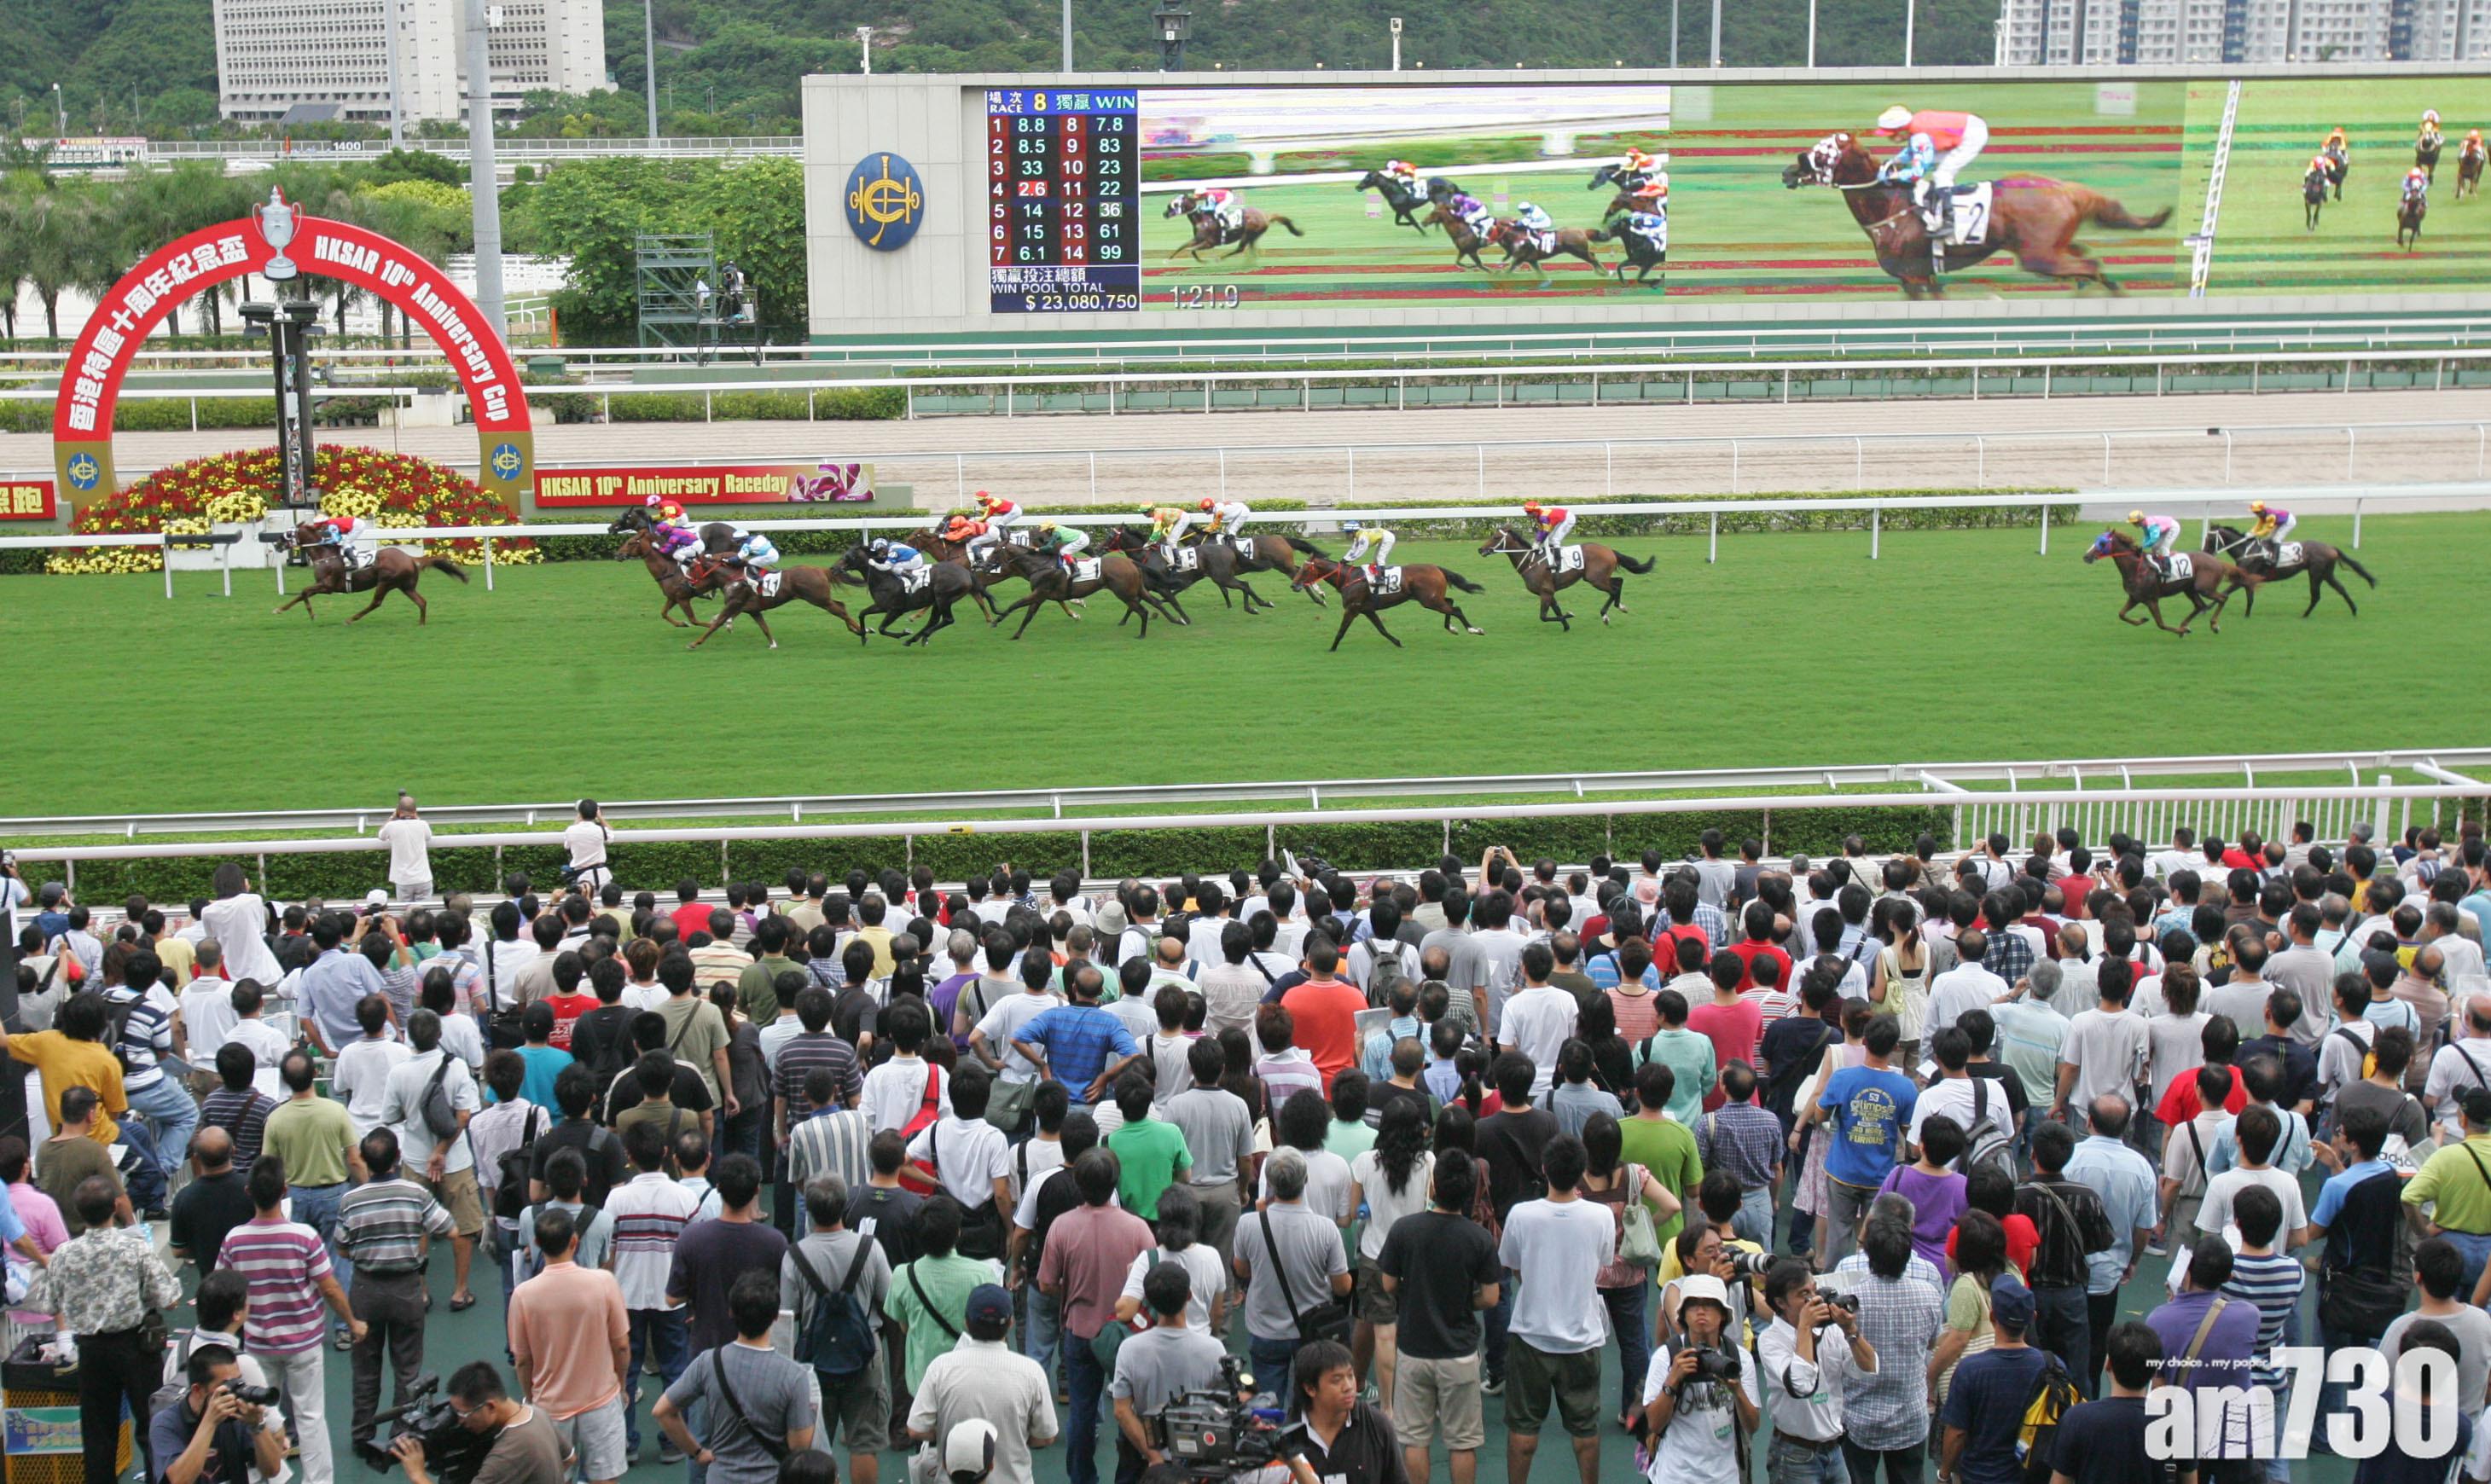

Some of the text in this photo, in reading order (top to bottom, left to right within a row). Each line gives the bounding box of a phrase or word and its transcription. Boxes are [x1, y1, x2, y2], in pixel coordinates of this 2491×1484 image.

[990, 91, 1022, 103] 場次
[1035, 93, 1047, 111] 8
[1056, 94, 1135, 110] 獨贏 WIN
[990, 104, 1023, 113] RACE
[993, 118, 1123, 132] 1 8.8 8 7.8
[333, 142, 361, 151] 1400
[993, 138, 1120, 154] 2 8.5 9 83
[993, 160, 1120, 175] 3 33 10 23
[993, 182, 1120, 196] 4 2.6 11 22
[994, 203, 1121, 217] 5 14 12 36
[1966, 202, 1984, 241] 2
[994, 224, 1118, 240] 6 15 13 61
[995, 246, 1121, 260] 7 6.1 14 99
[991, 282, 1105, 293] WIN POOL TOTAL
[1042, 294, 1136, 310] 23,080,750
[69, 235, 248, 431] 香港特區十周年紀念盃
[314, 235, 509, 421] HKSAR 10th Anniversary Cup
[541, 472, 787, 496] HKSAR 10th Anniversary Raceday
[1243, 542, 1252, 558] 4
[2292, 546, 2302, 563] 3
[365, 554, 374, 564] 2
[1187, 551, 1196, 567] 5
[1572, 551, 1582, 569] 9
[1093, 563, 1100, 577] 1
[2175, 559, 2192, 577] 12
[1385, 574, 1400, 592] 13
